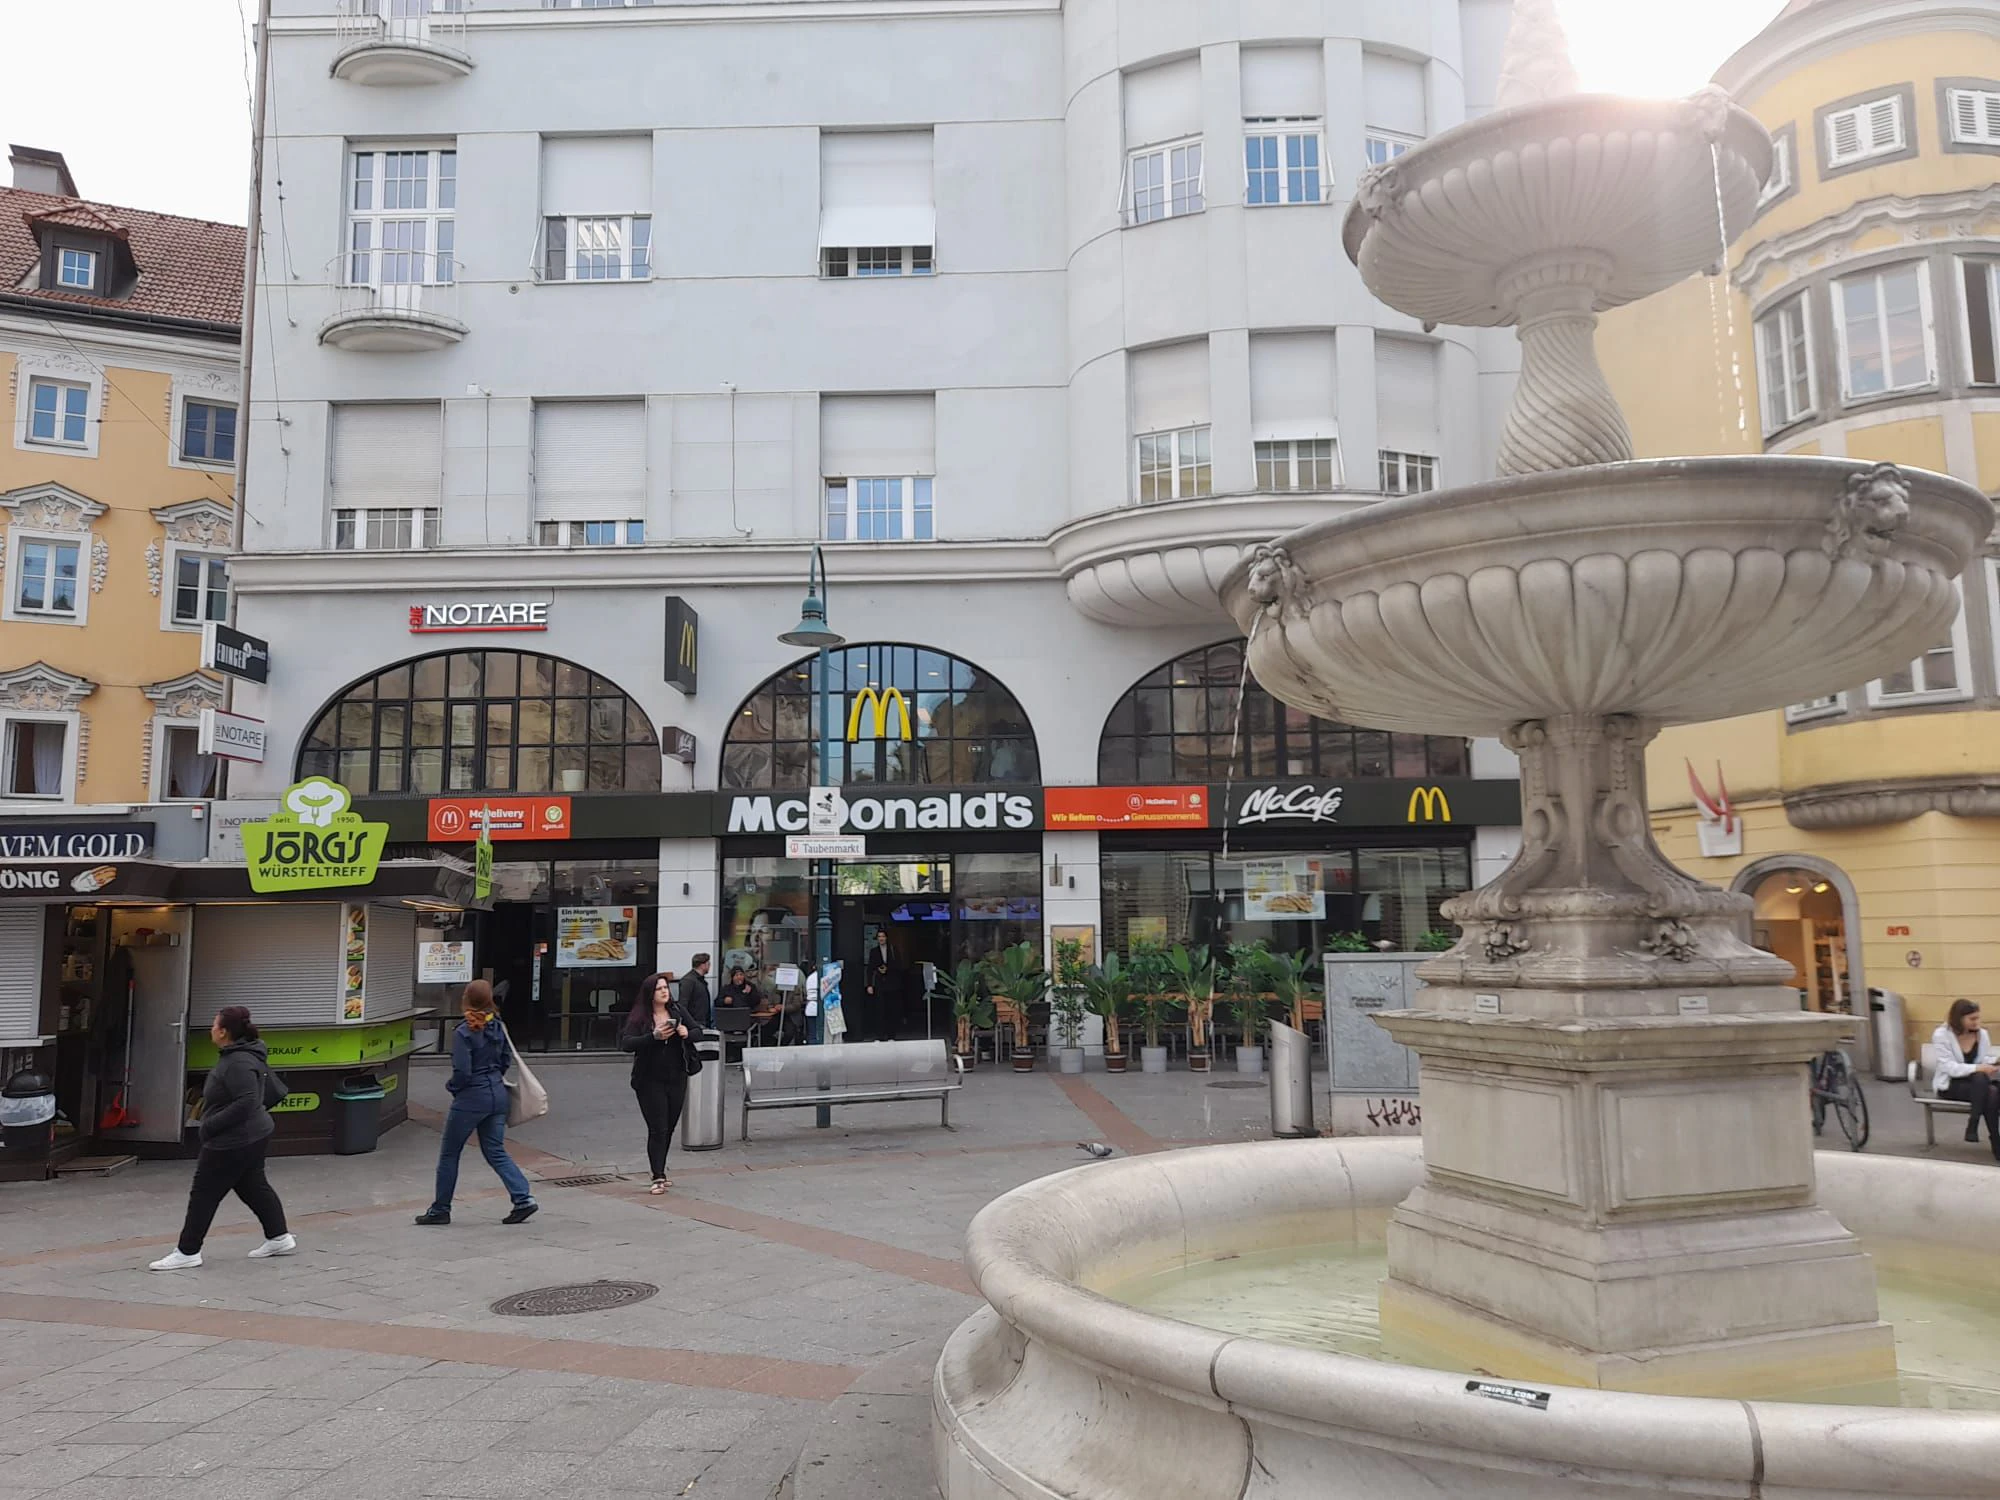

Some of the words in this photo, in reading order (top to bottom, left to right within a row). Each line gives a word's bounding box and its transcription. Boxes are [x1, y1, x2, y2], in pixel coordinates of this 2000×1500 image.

[426, 603, 547, 625] NOTARE
[221, 724, 262, 746] NOTARE
[1238, 784, 1343, 823] McCafé
[337, 816, 355, 824] 1950
[1051, 813, 1067, 822] Wir
[1068, 812, 1096, 822] liefern
[67, 833, 145, 857] GOLD
[802, 843, 860, 854] Taubenmarkt
[0, 868, 61, 890] ÖNIG
[258, 864, 367, 878] WÜRSTELTREFF
[266, 1046, 304, 1056] ERKAUF
[1479, 1384, 1537, 1401] SNIPES.COM
